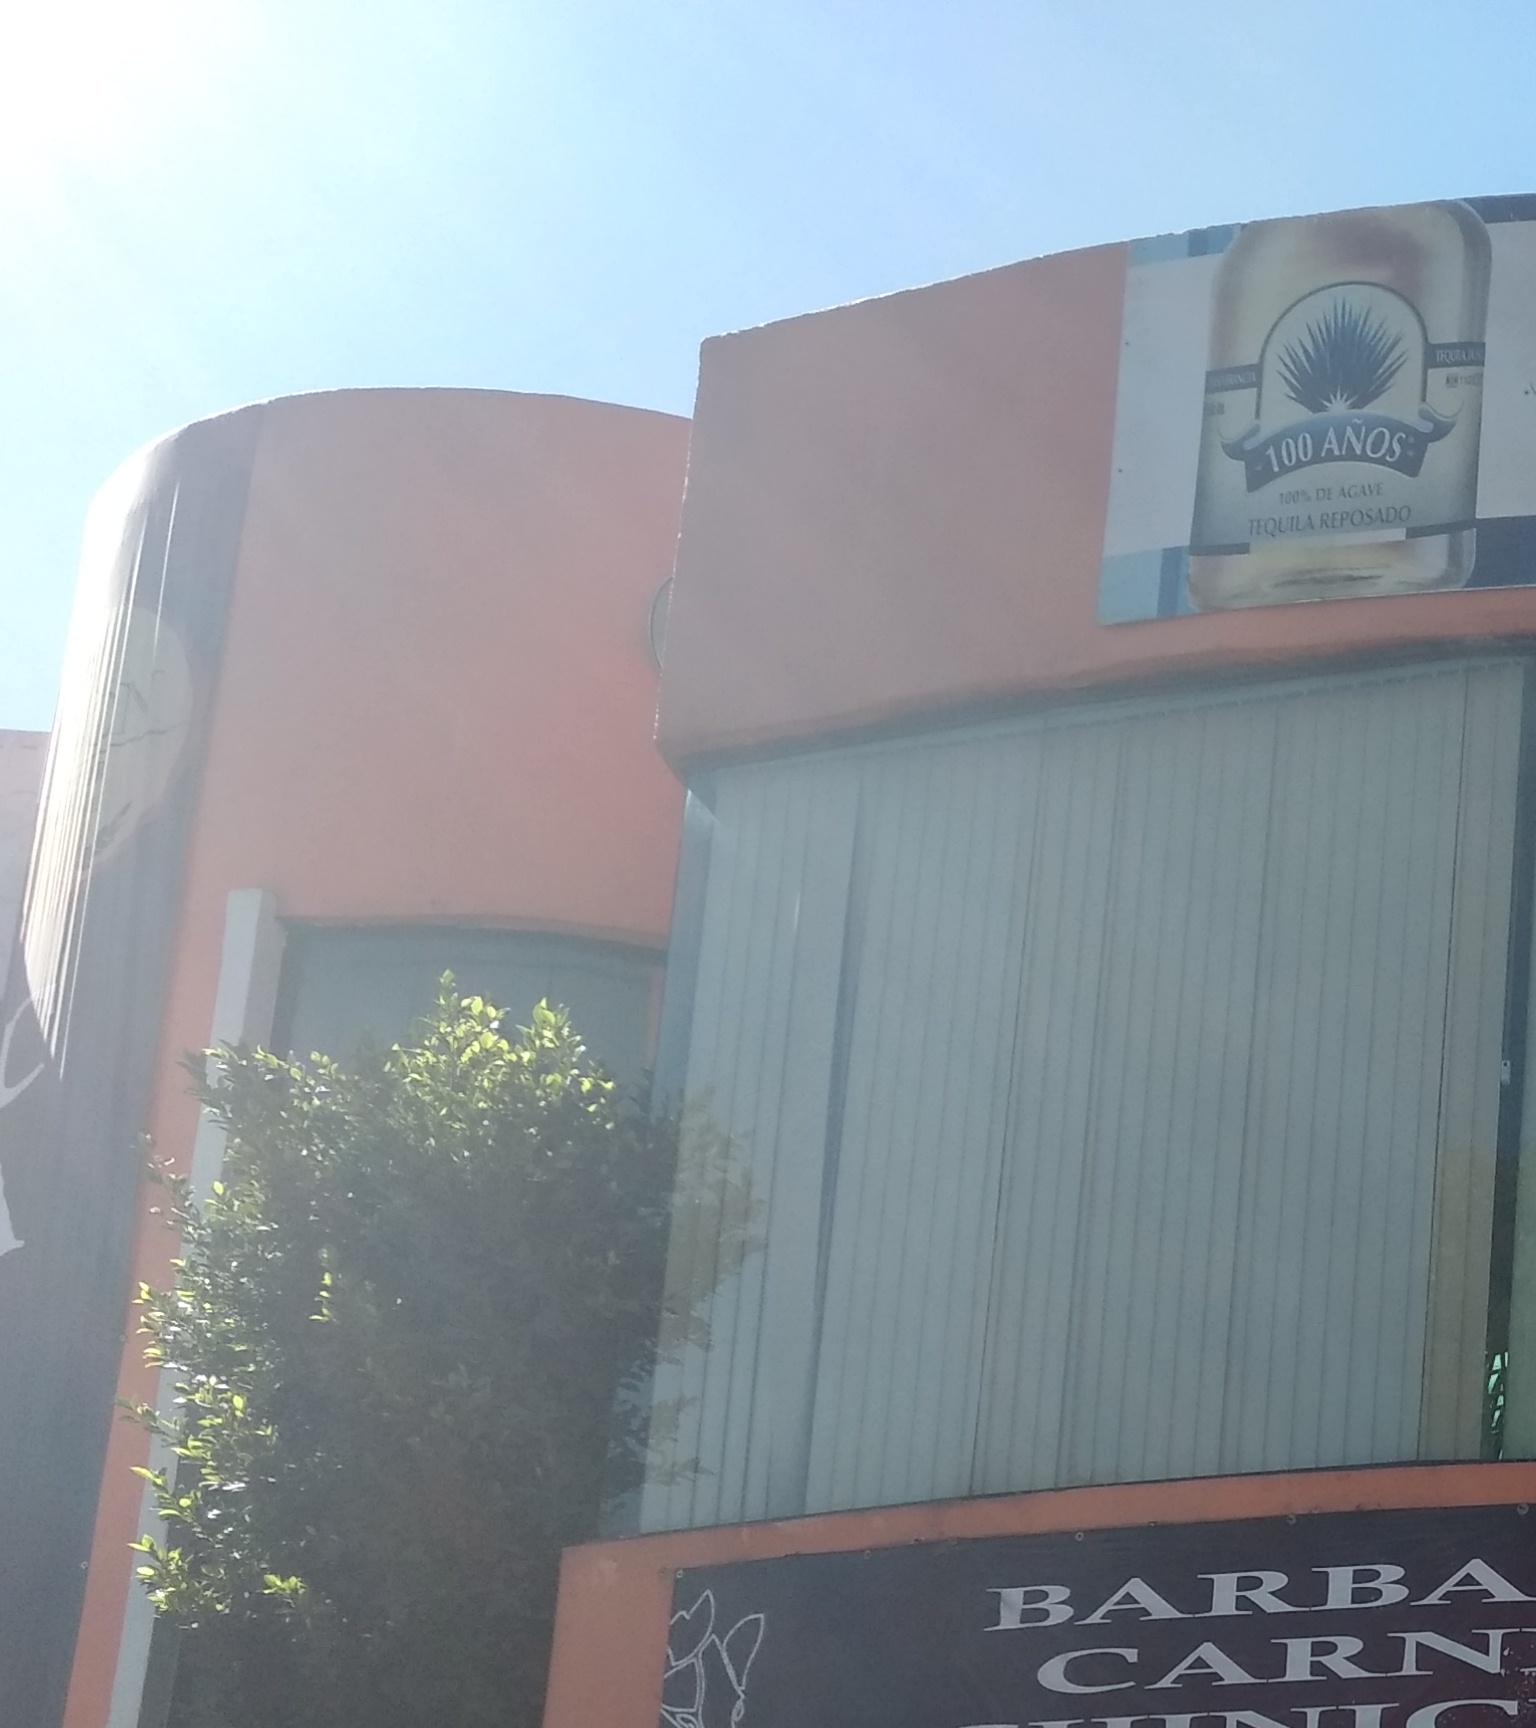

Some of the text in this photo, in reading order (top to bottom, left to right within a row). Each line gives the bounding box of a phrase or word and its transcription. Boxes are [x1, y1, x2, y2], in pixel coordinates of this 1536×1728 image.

[1265, 417, 1407, 474] 100 AÑOS
[1315, 488, 1337, 502] DE
[1338, 482, 1384, 500] AGAVE
[1248, 504, 1412, 538] TEQUILA REPOSADO
